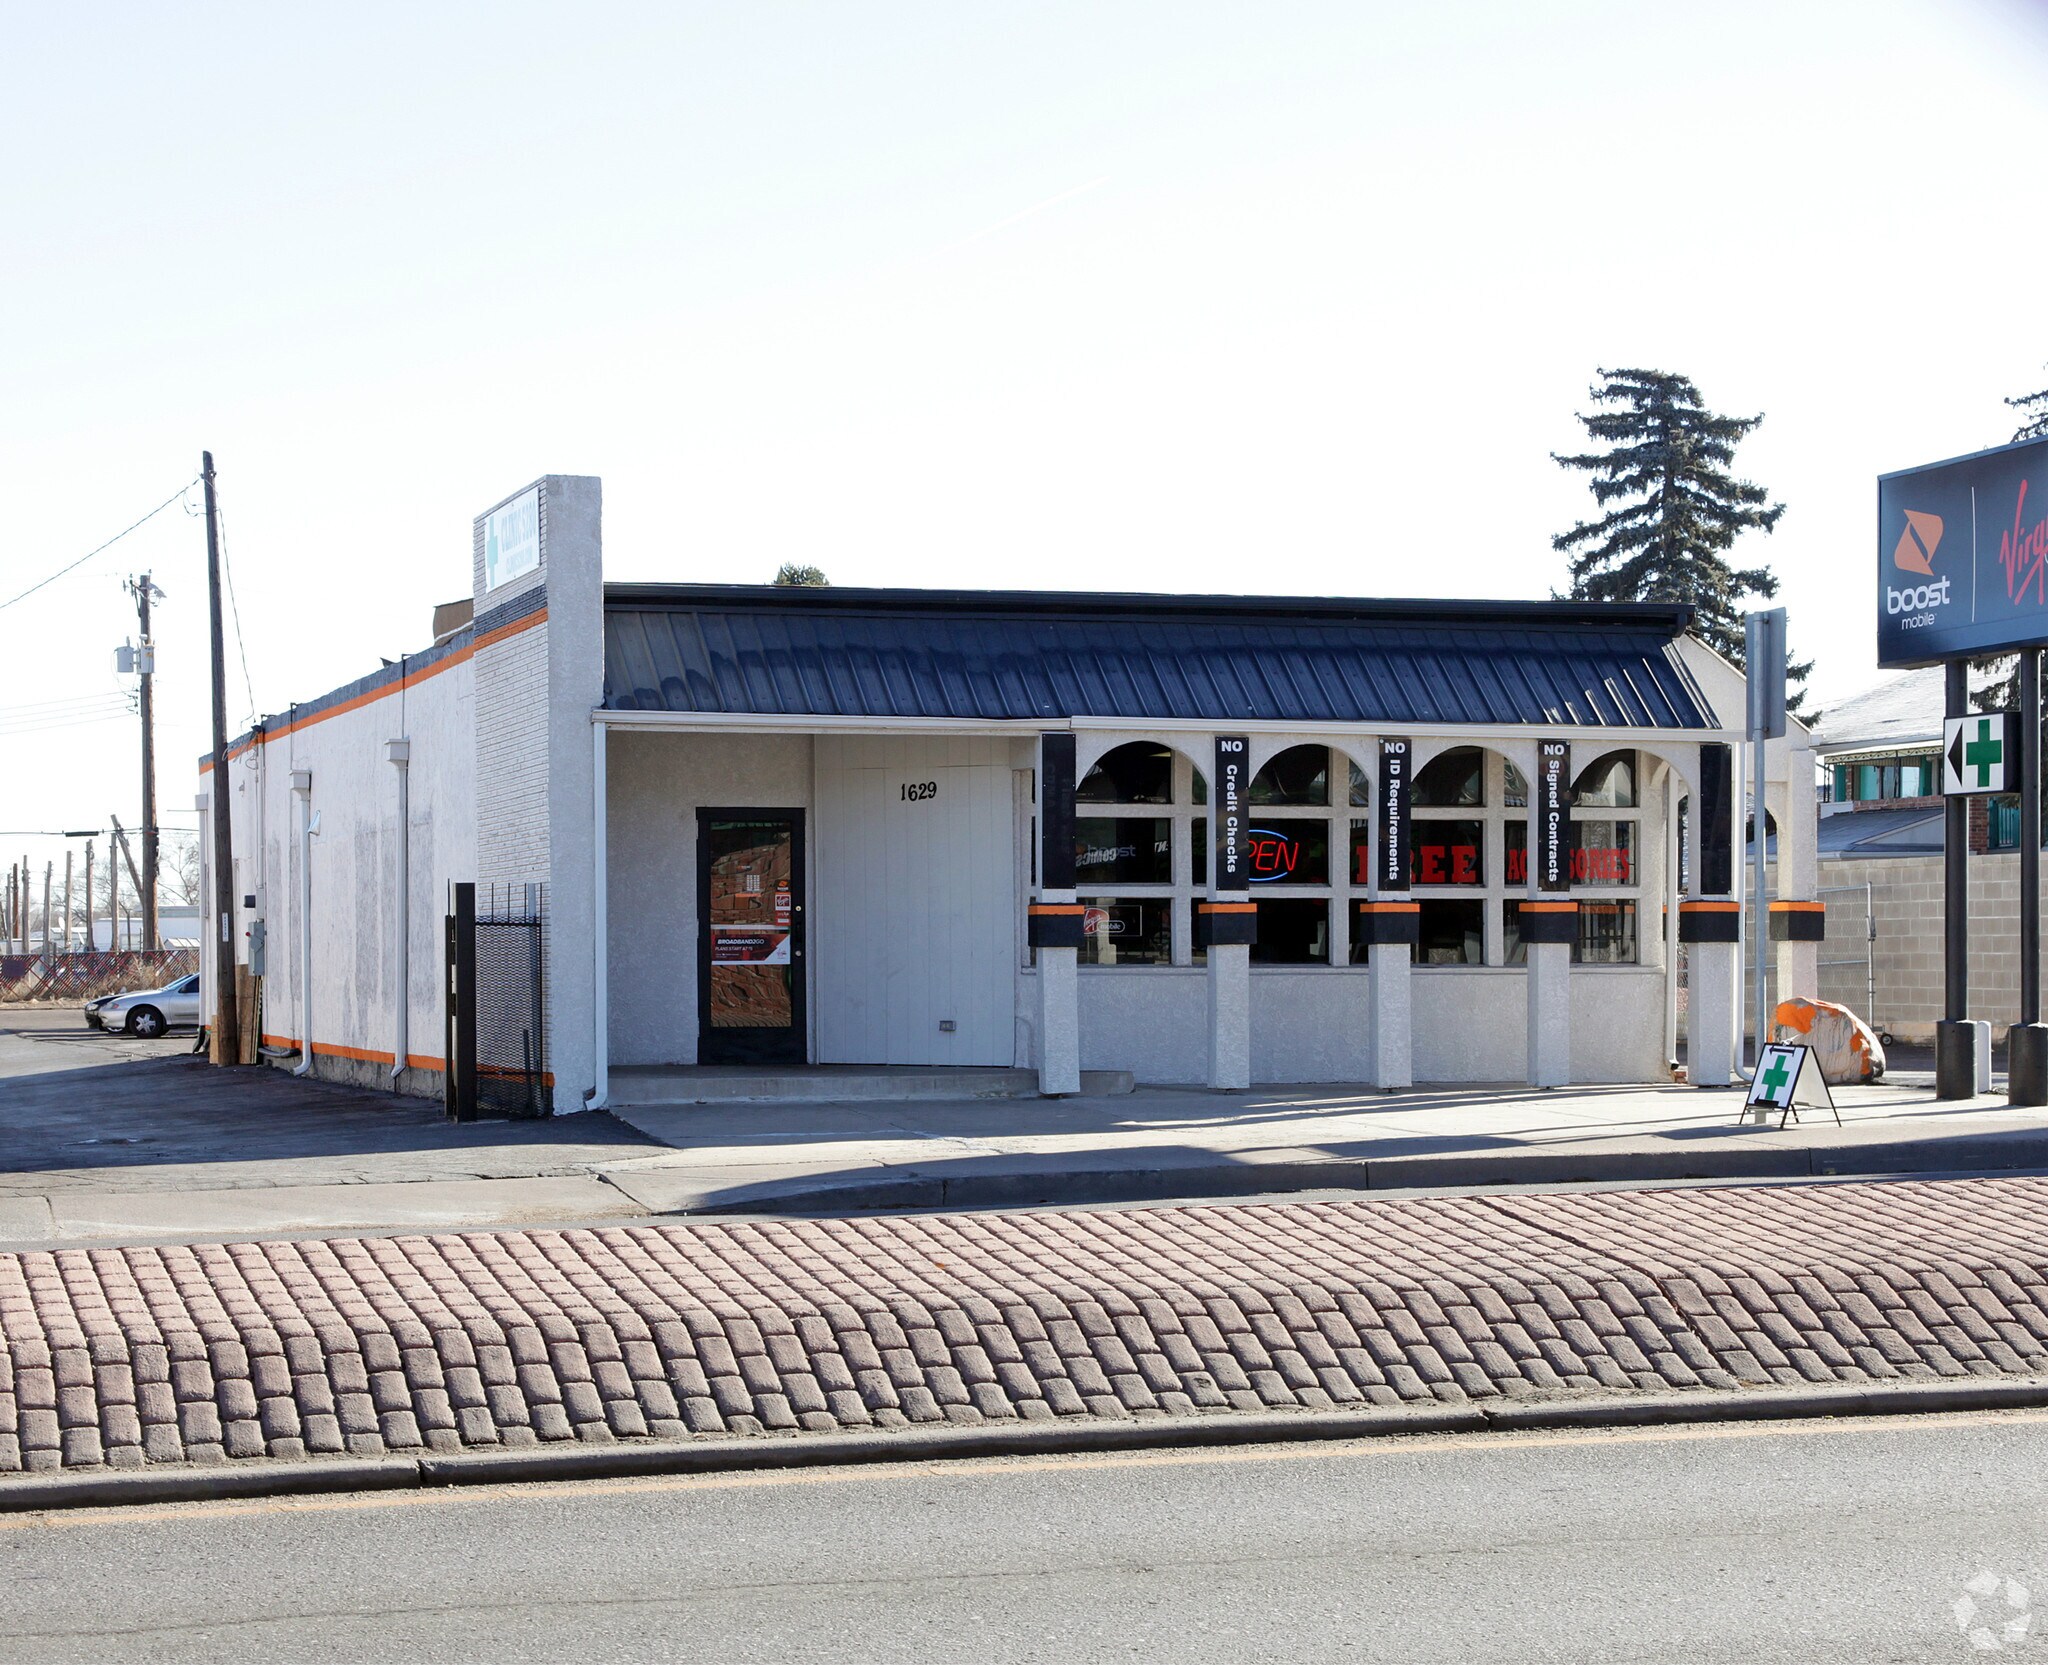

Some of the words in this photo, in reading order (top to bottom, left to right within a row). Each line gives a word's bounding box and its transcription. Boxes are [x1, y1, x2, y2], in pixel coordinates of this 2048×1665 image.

[1998, 479, 2048, 605] Virg
[1887, 575, 1950, 614] boost
[1901, 613, 1935, 630] mobile
[1221, 741, 1243, 752] NO
[1384, 742, 1406, 754] NO
[1544, 744, 1565, 755] NO
[1389, 759, 1401, 775] ID
[901, 781, 938, 802] 1629
[1226, 765, 1238, 812] Credit
[1546, 760, 1560, 808] Signed
[1226, 816, 1238, 873] Checks
[1387, 780, 1401, 880] Requirements
[1249, 840, 1299, 871] PEN
[1548, 812, 1560, 882] Contracts
[1100, 922, 1121, 930] mobile
